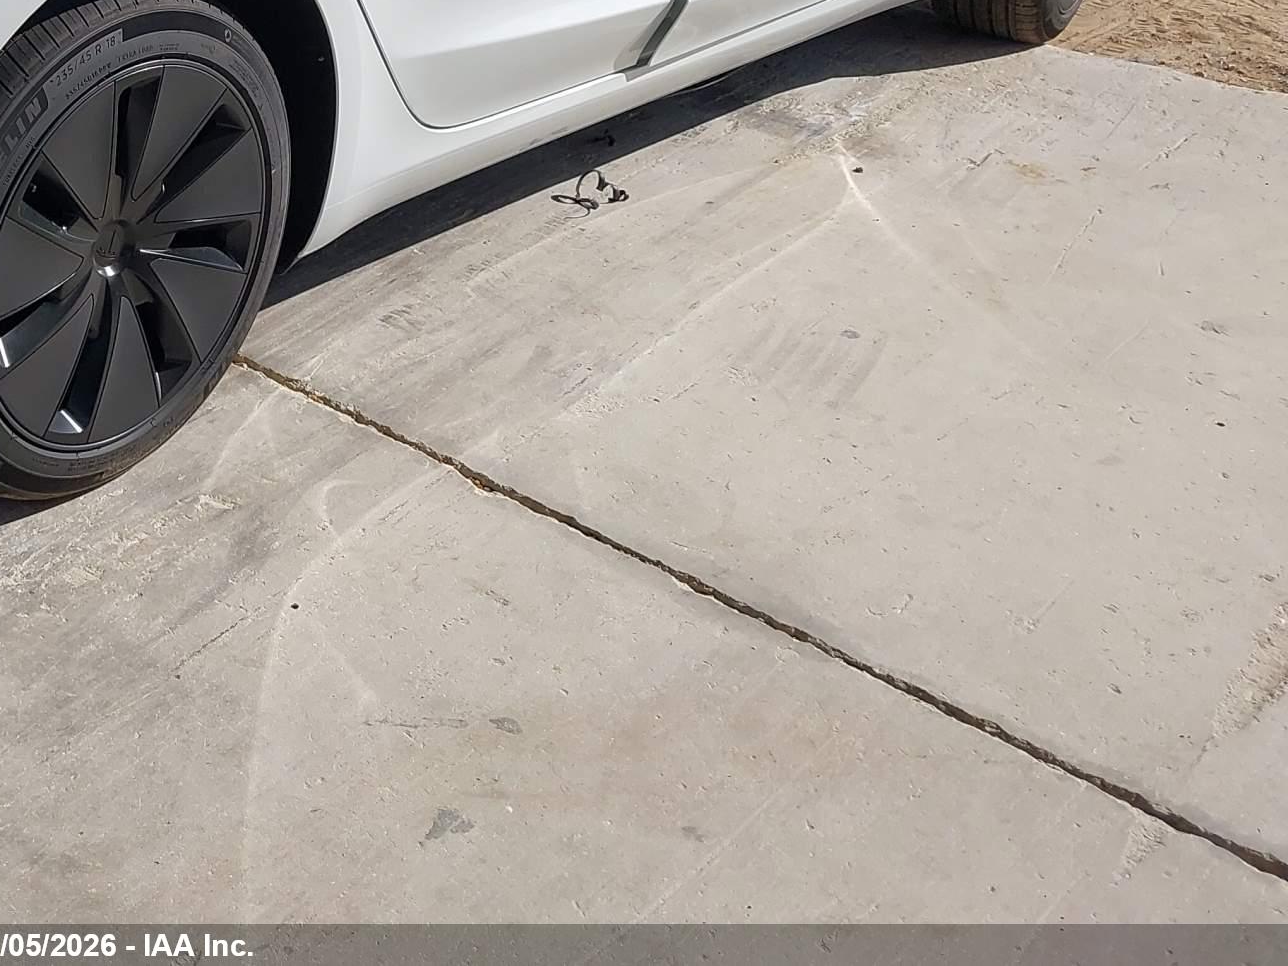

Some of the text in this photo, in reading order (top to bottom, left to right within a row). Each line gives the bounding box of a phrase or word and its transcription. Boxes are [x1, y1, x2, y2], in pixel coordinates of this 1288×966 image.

[56, 36, 116, 87] 235/45 R 18
